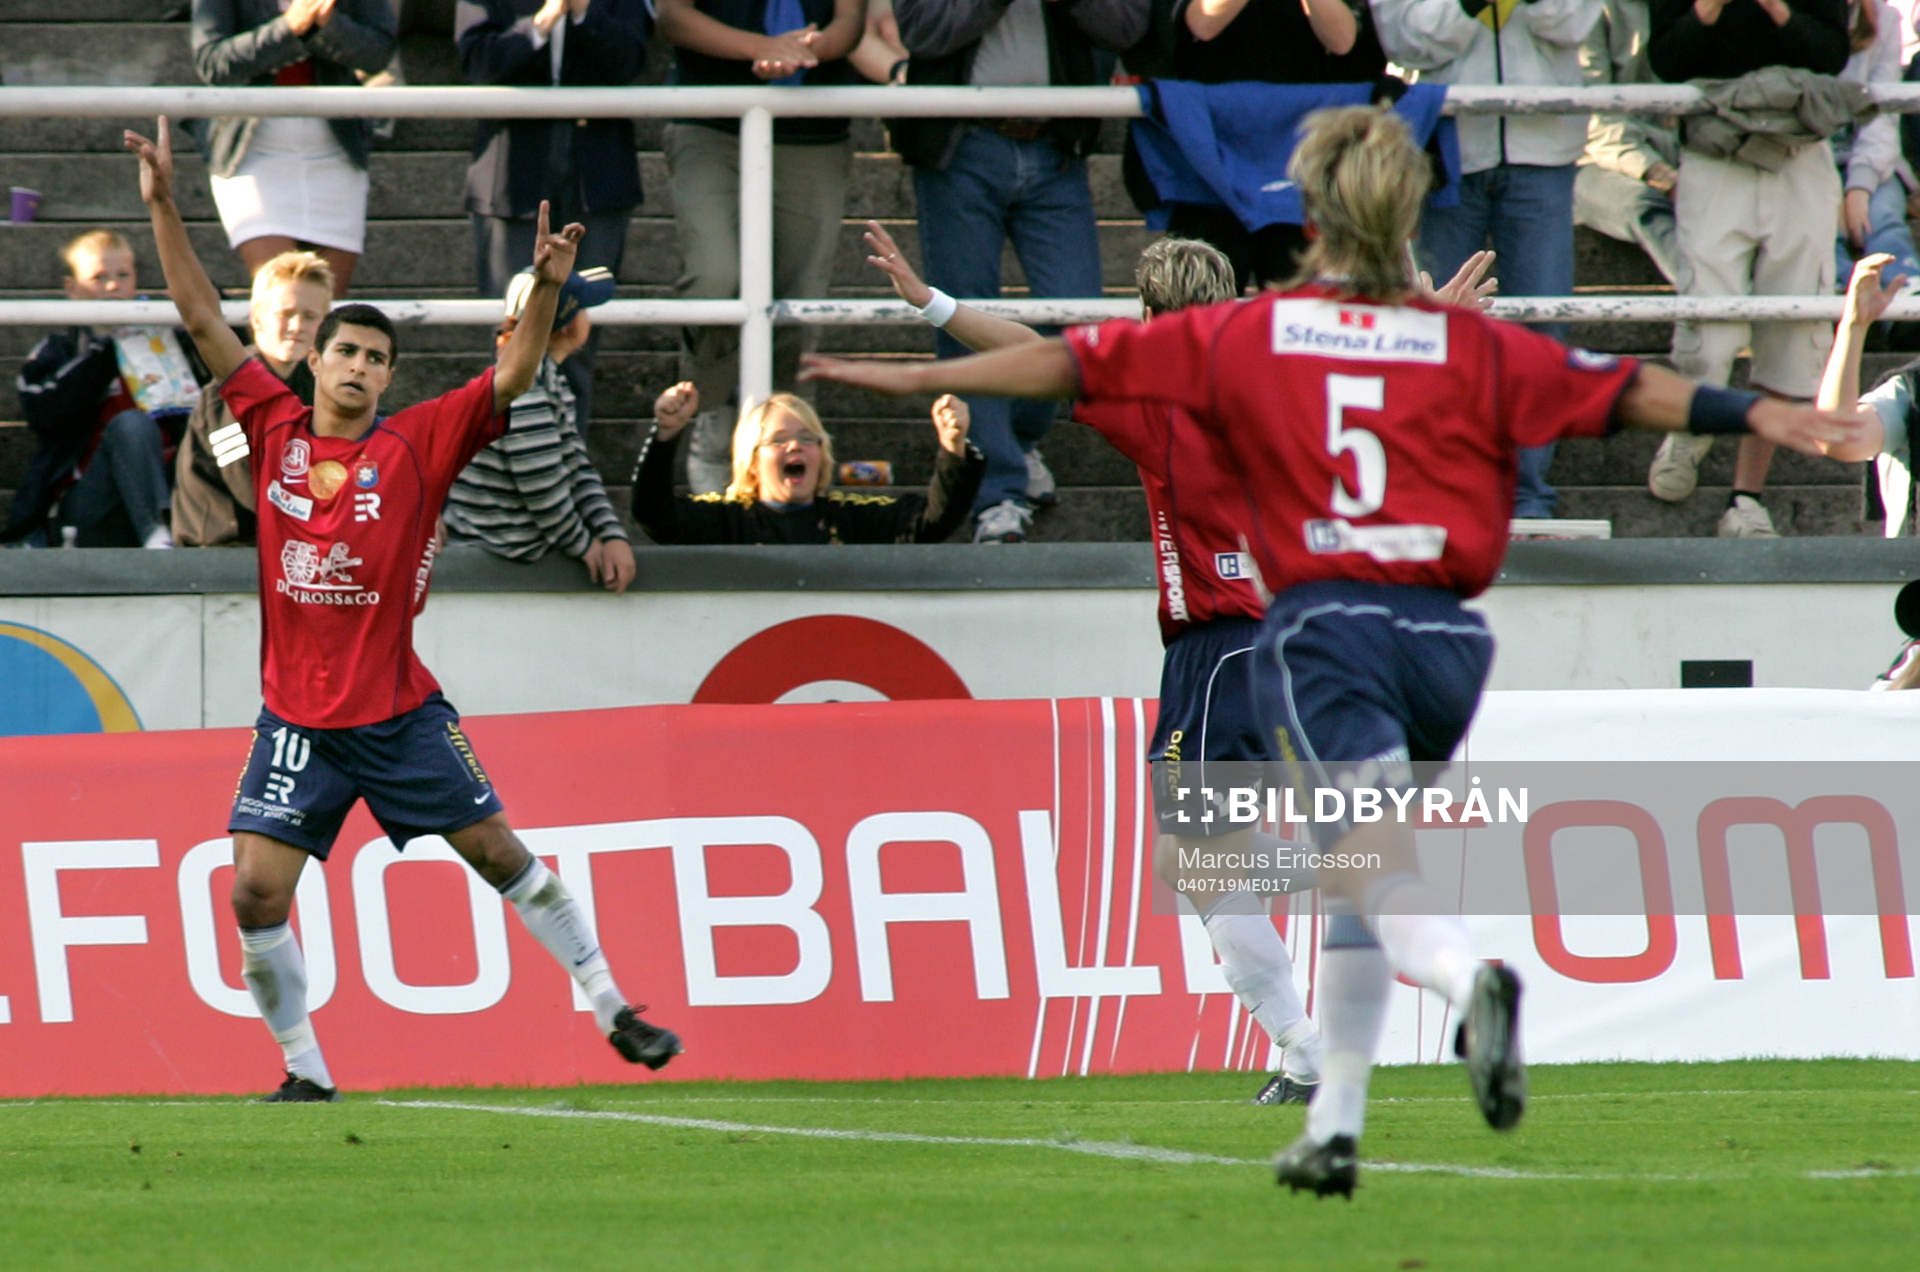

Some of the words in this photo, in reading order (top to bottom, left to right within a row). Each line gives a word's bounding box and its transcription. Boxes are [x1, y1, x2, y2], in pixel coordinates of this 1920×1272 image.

[1284, 324, 1368, 349] Stena
[1374, 333, 1438, 353] Line
[1326, 372, 1387, 518] 5
[271, 726, 311, 772] 10
